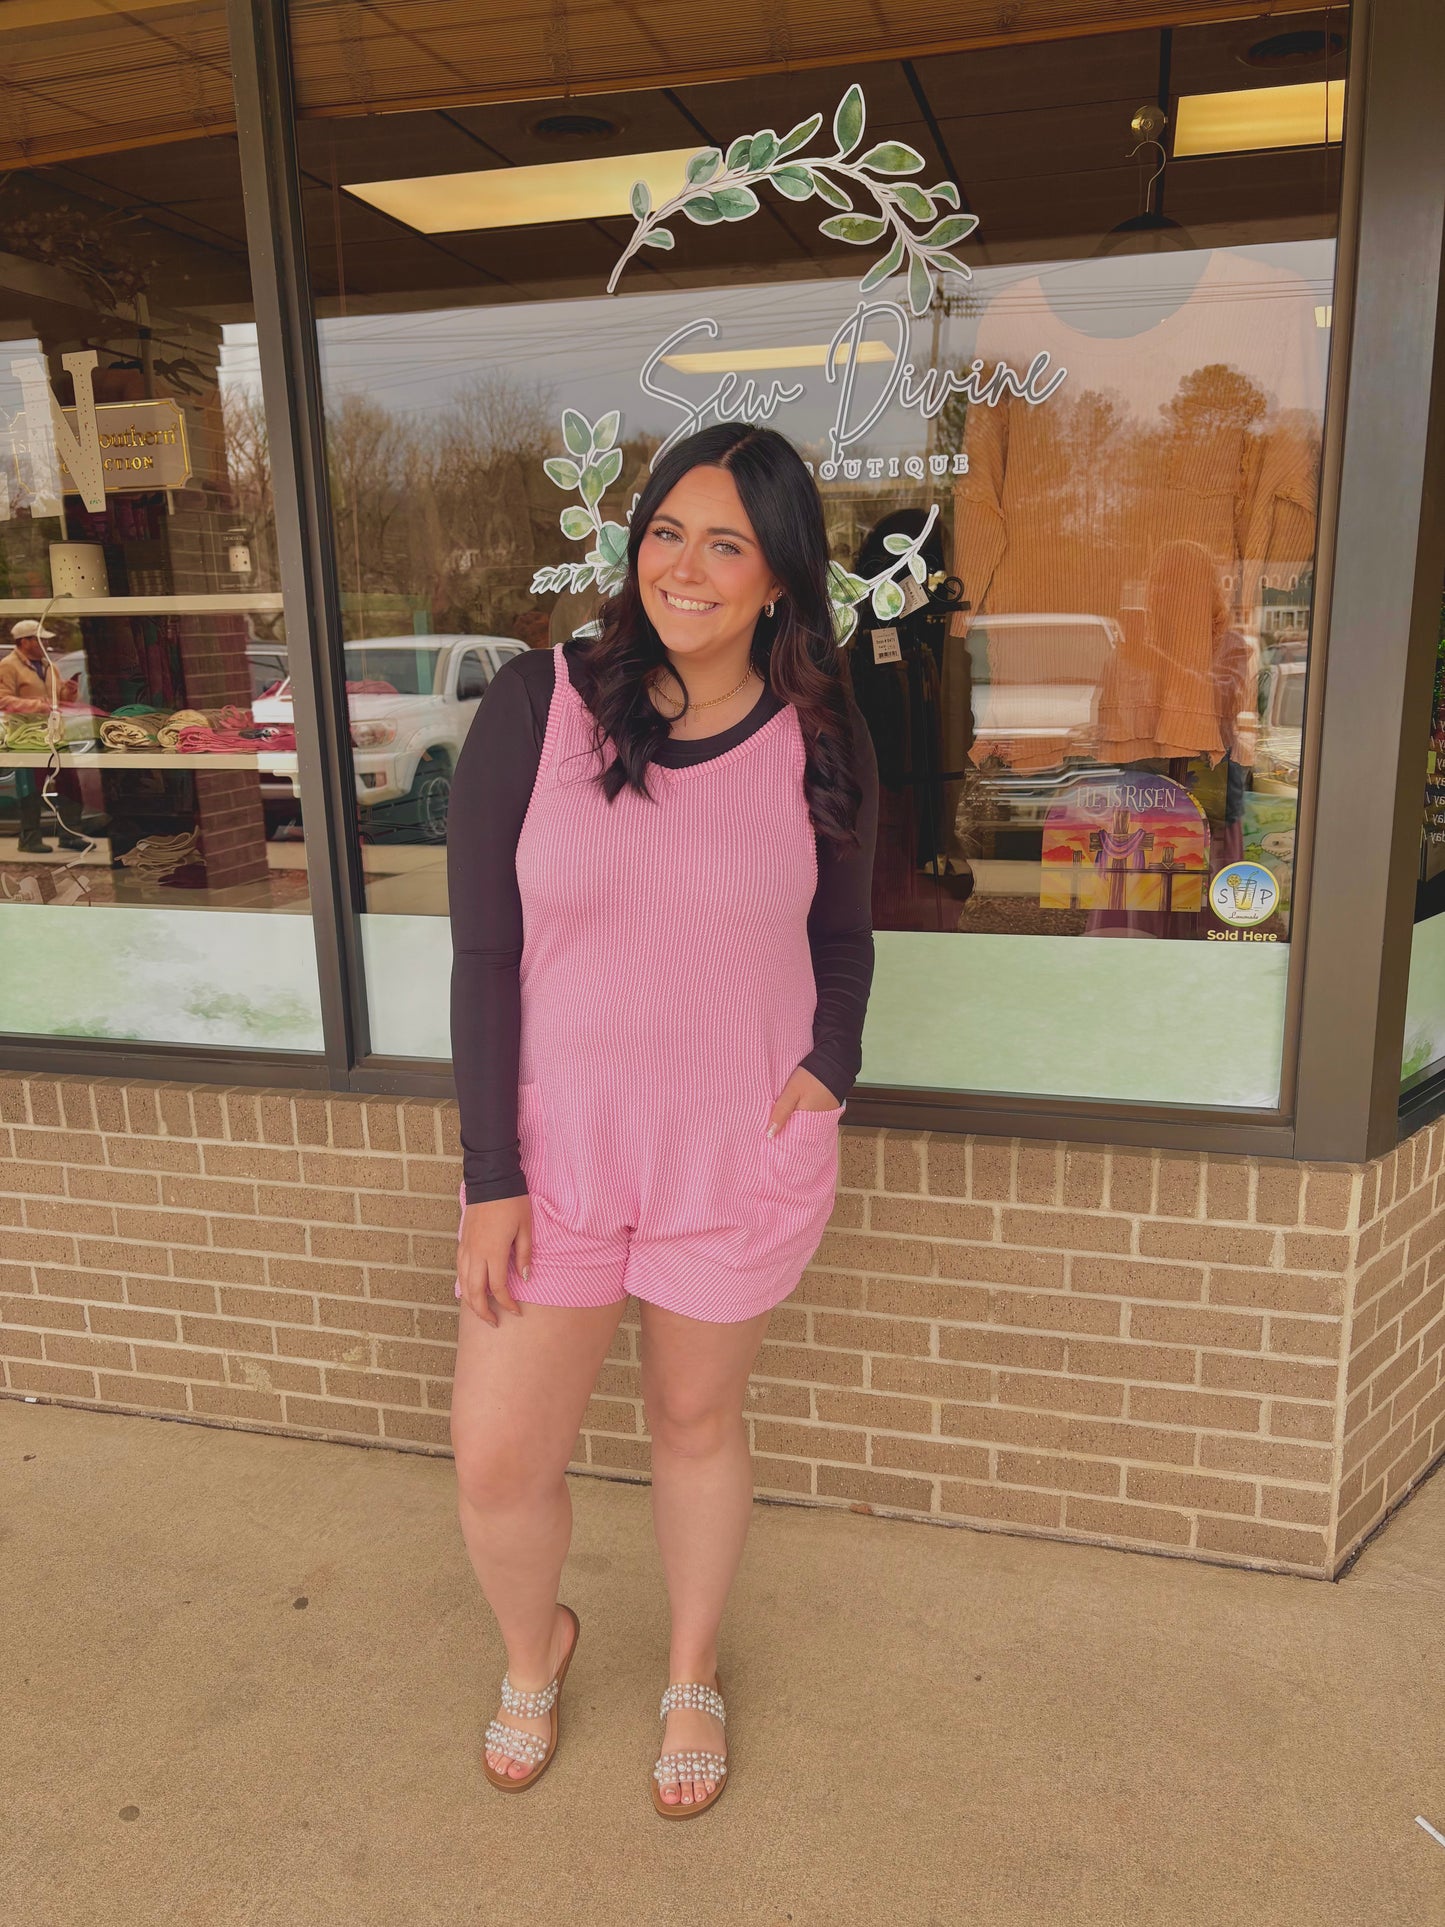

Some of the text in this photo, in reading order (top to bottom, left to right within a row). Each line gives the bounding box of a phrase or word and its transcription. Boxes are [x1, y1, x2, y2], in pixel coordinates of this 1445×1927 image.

[640, 300, 1068, 474] Sew Divine
[99, 424, 177, 449] outhern
[1124, 784, 1177, 813] RISEN
[1206, 929, 1278, 942] Sold Here
